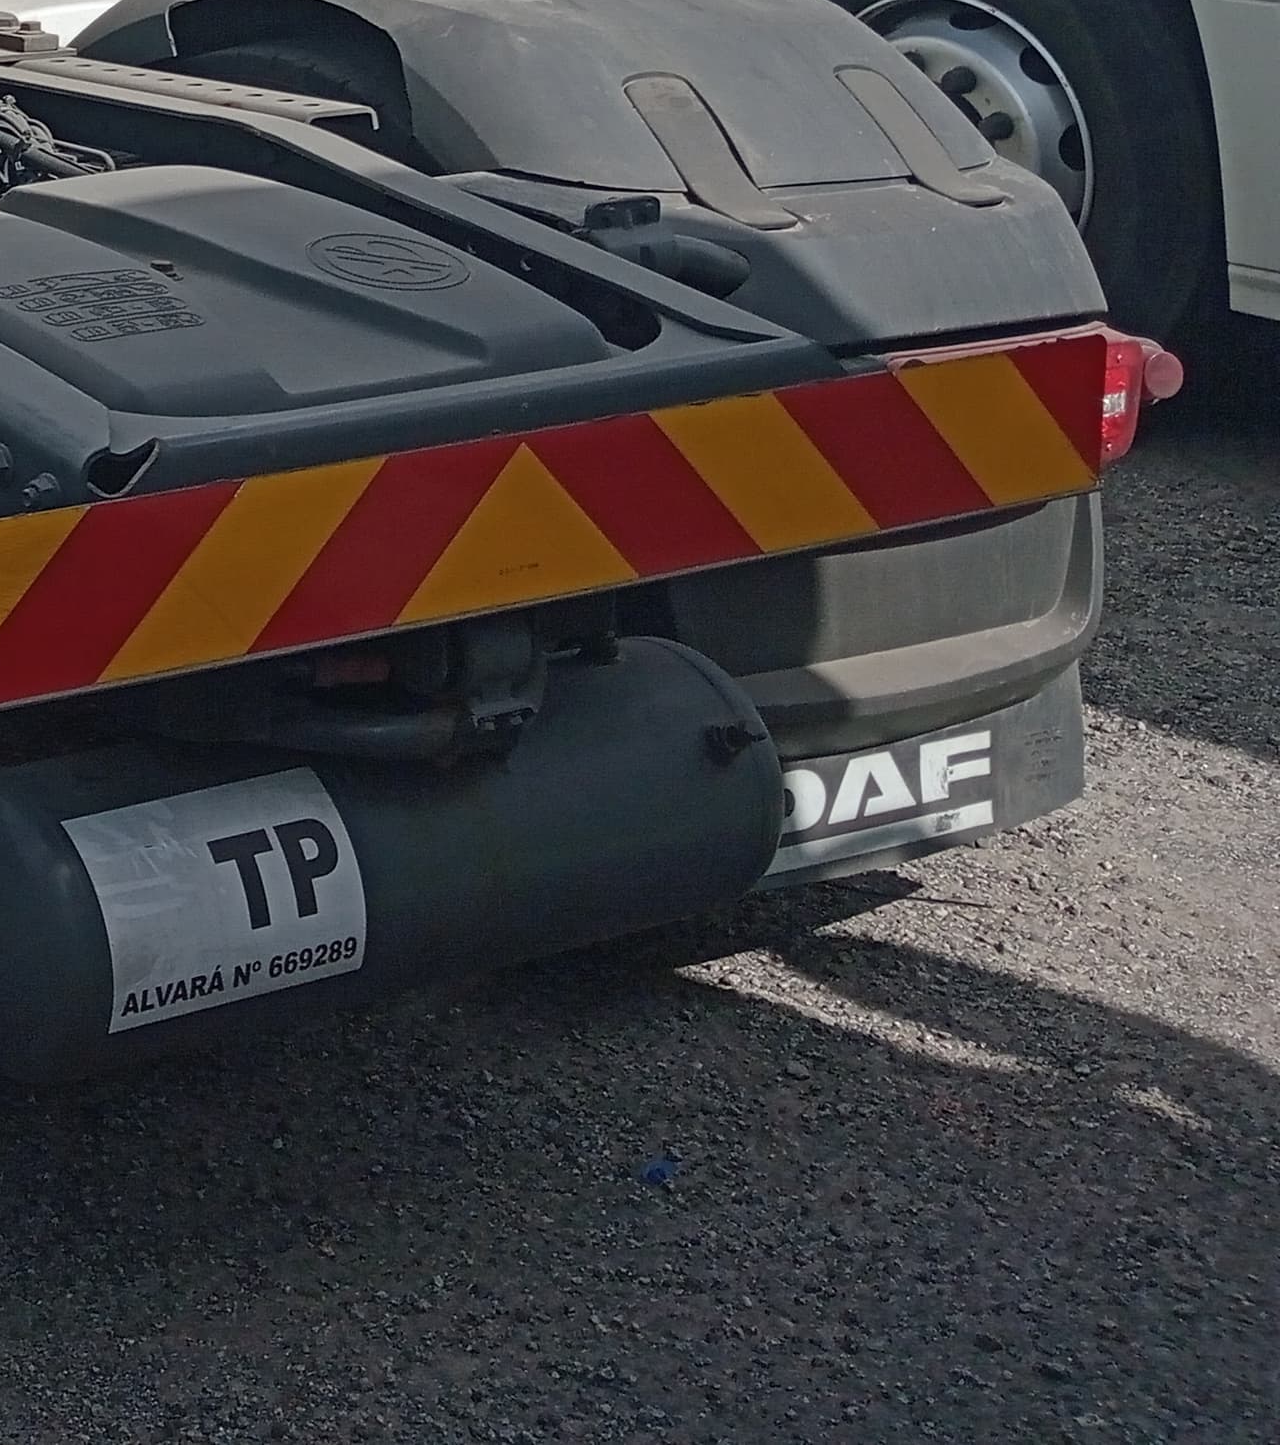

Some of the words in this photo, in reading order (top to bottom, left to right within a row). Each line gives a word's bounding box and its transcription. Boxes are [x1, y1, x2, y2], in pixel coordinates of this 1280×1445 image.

[206, 818, 339, 930] TP
[120, 965, 225, 1017] ALVARÁ
[268, 937, 358, 979] 669289
